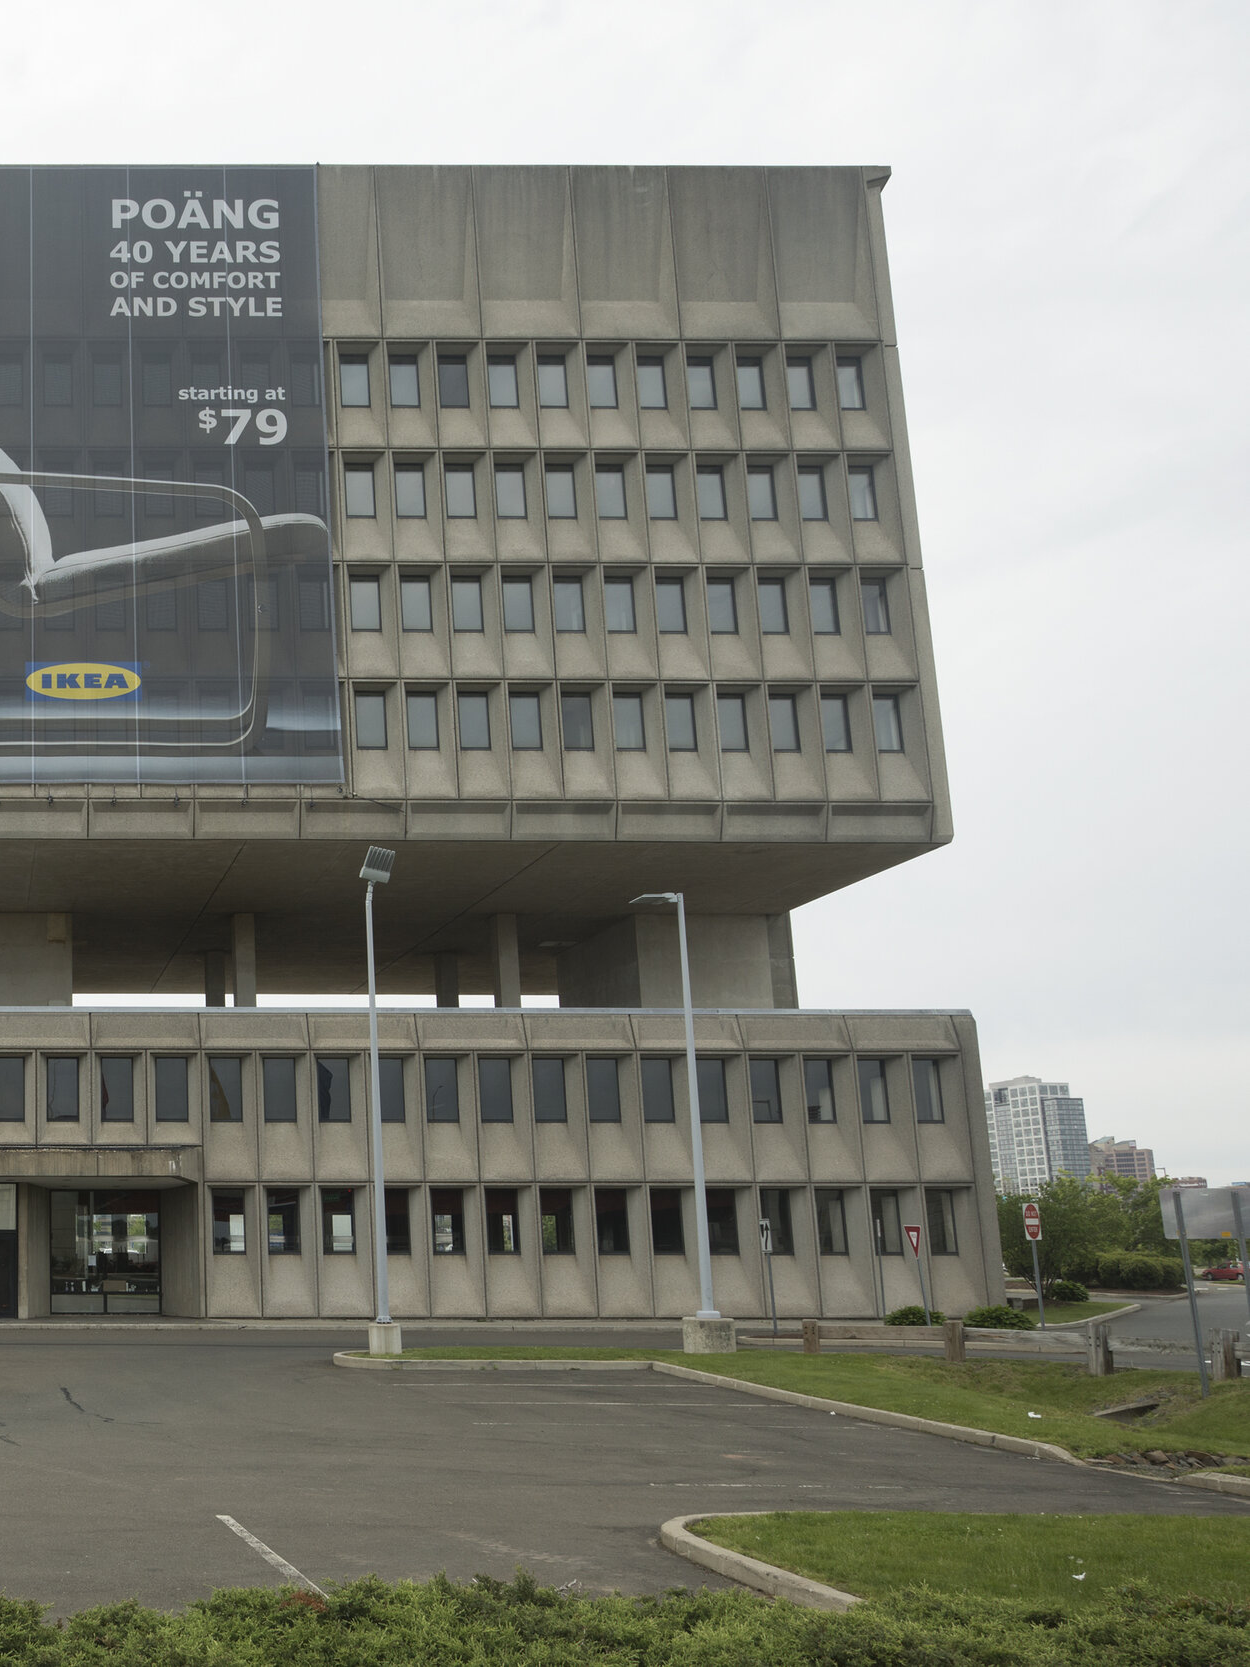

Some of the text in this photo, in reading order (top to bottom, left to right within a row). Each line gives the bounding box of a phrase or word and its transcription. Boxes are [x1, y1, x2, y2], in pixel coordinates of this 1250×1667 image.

[111, 191, 280, 229] POÄNG
[109, 240, 281, 263] 40 YEARS
[109, 271, 281, 289] OF COMFORT
[109, 297, 283, 317] AND STYLE
[178, 385, 286, 404] starting at
[198, 406, 288, 445] $79
[41, 673, 129, 689] IKEA
